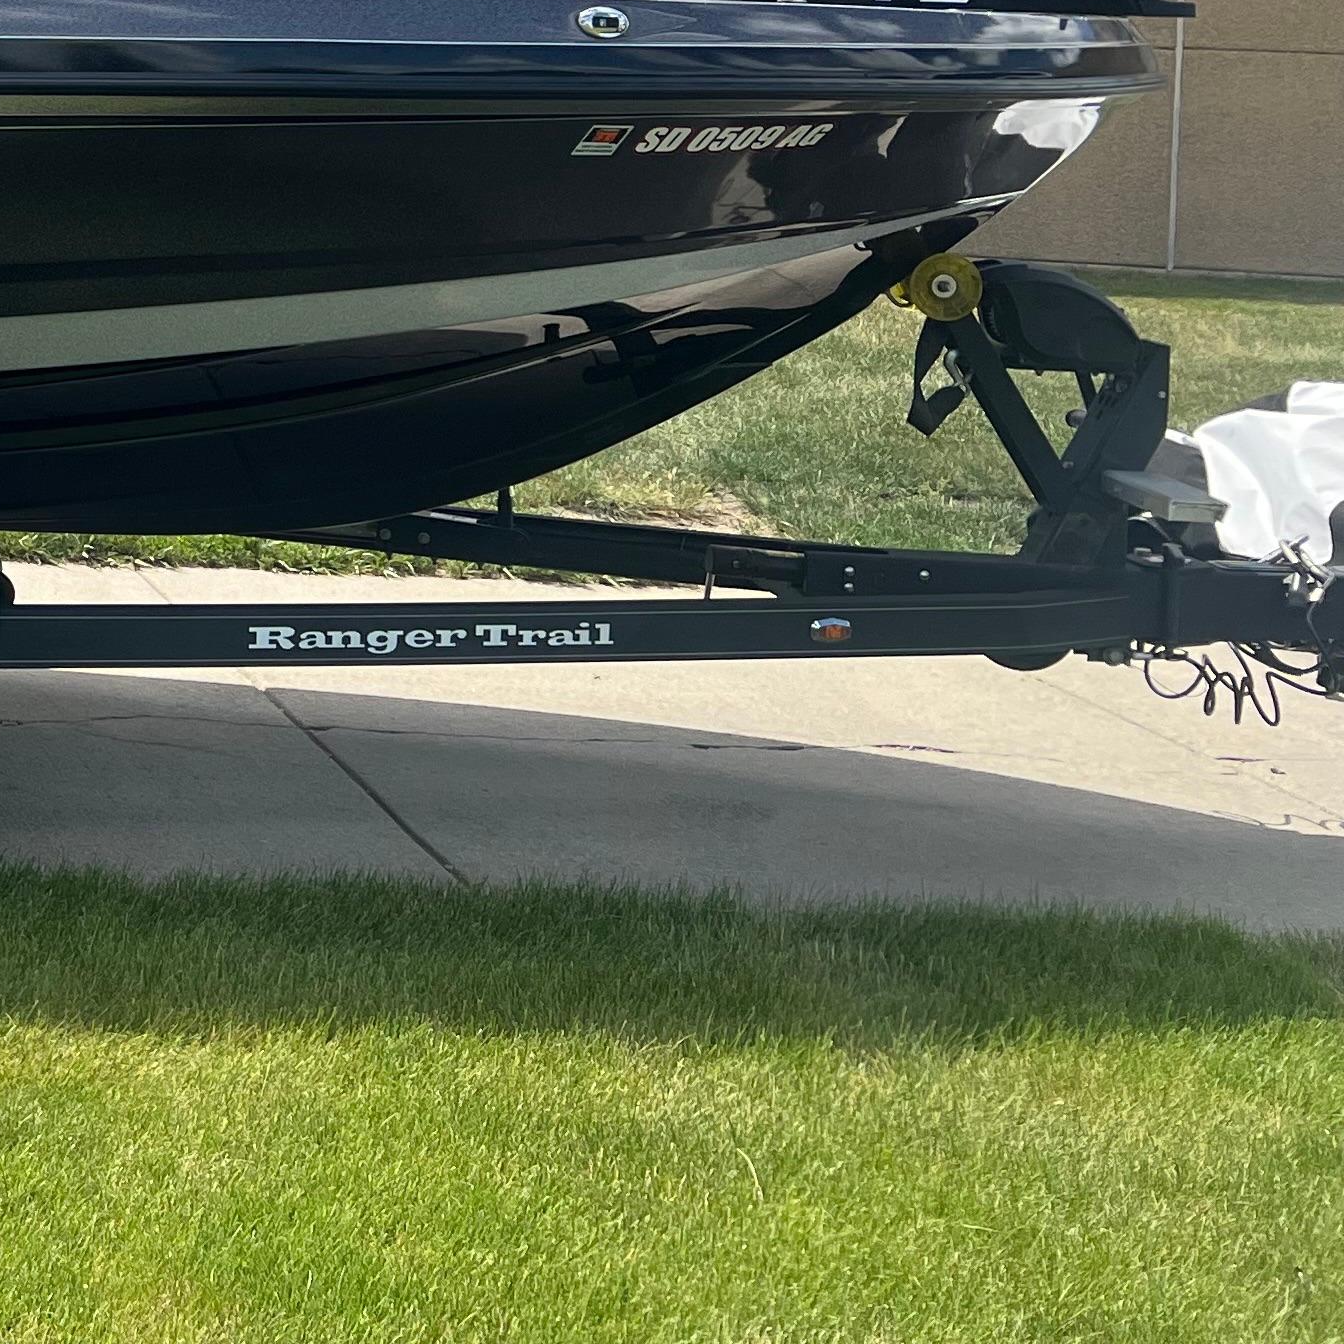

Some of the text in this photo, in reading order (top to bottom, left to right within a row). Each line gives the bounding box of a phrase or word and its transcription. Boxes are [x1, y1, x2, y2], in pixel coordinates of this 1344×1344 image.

[635, 123, 834, 153] SD 0509 AG
[248, 622, 614, 654] Ranger Trail
